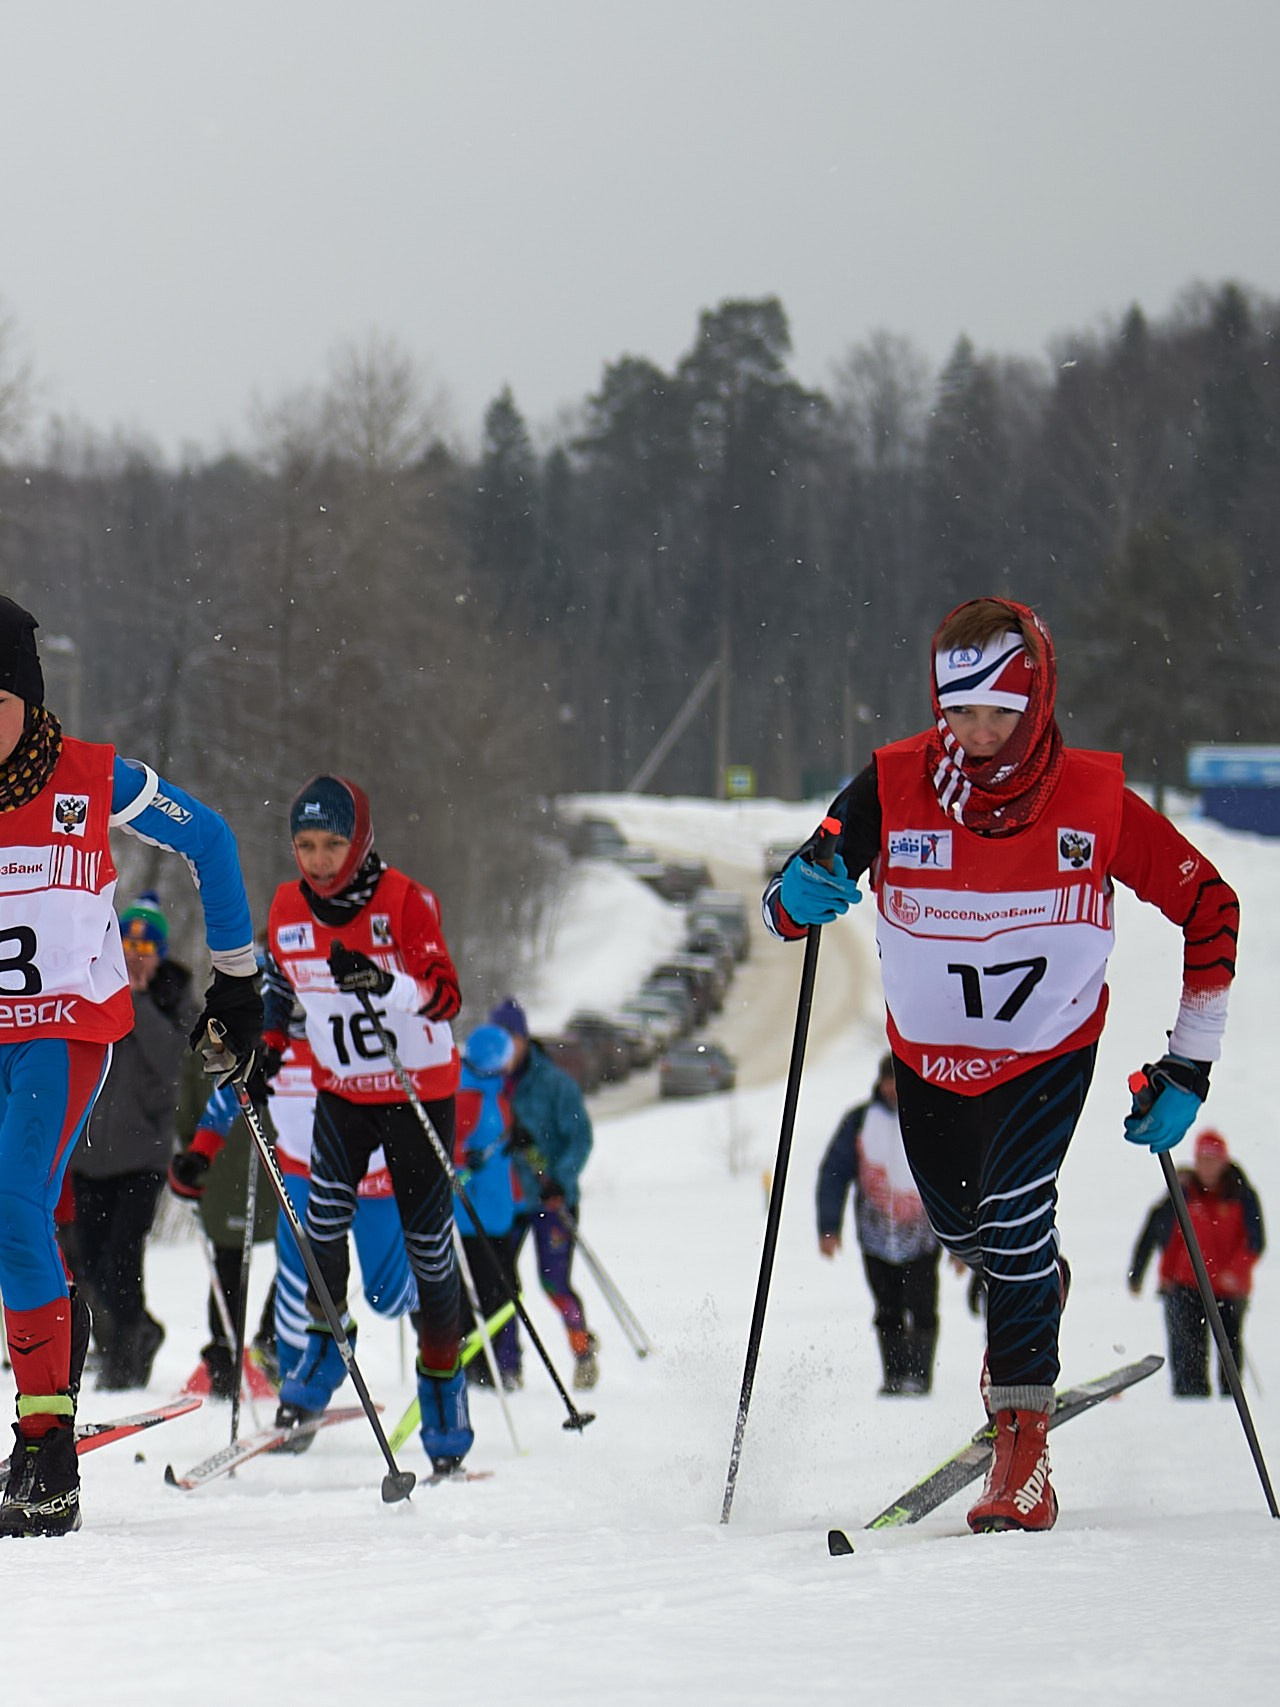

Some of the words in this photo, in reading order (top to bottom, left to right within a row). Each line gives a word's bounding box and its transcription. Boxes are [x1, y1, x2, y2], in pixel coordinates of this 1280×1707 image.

[890, 843, 920, 855] СБР
[924, 904, 1047, 923] РоссельхозБанк
[947, 956, 1048, 1023] 17
[328, 1009, 398, 1066] 16
[422, 1023, 434, 1044] 1
